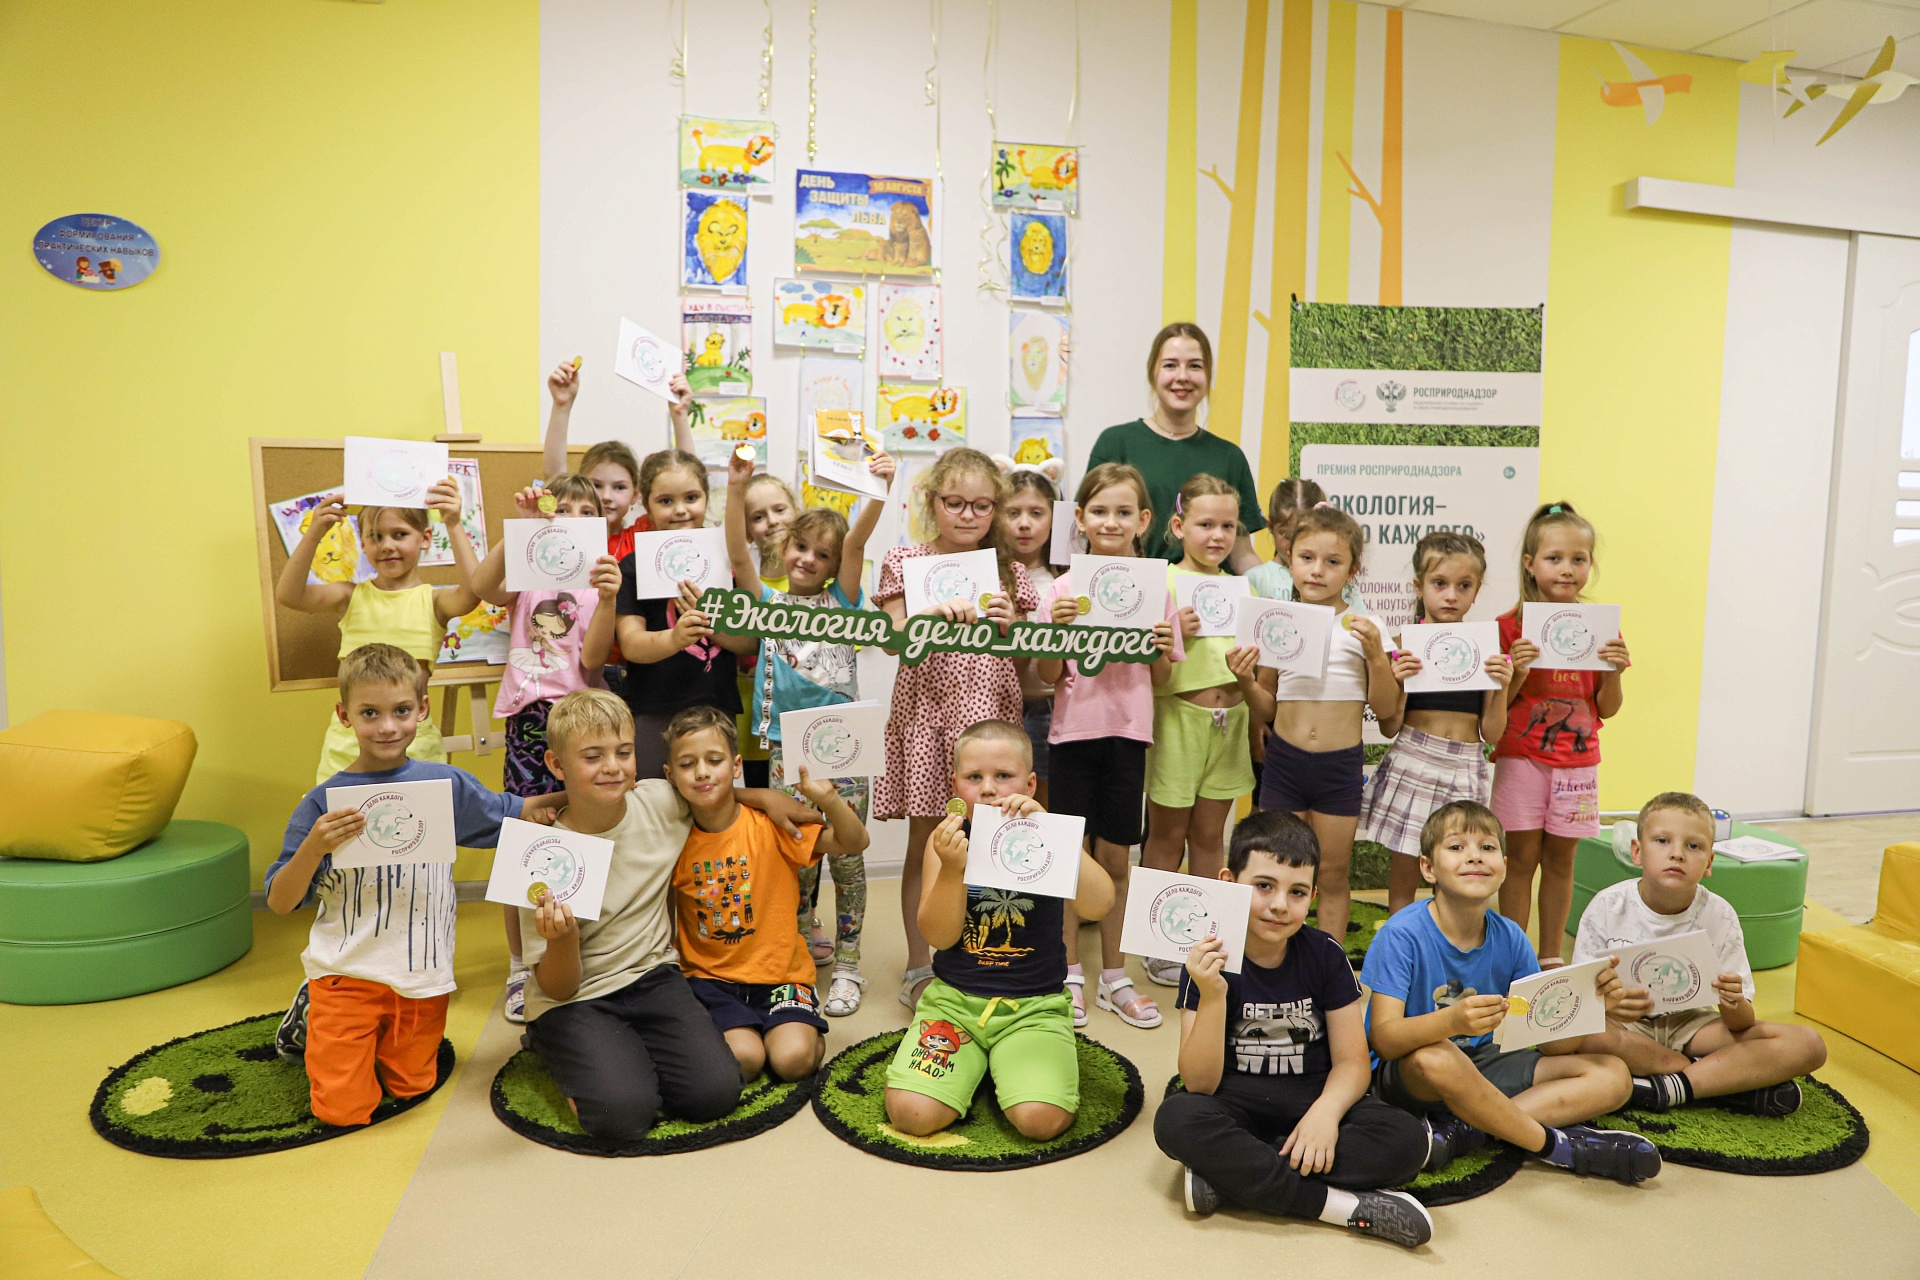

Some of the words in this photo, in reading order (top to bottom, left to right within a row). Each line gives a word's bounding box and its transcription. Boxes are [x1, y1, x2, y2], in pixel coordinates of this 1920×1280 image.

[799, 174, 835, 189] ДЕНЬ
[873, 182, 883, 191] 10
[886, 182, 922, 194] АВГУСТА
[810, 190, 869, 206] ЗАЩИТЫ
[852, 211, 886, 225] ЛЬВА
[58, 229, 134, 240] ФОРМИРОВАНИЯ
[38, 241, 108, 253] ПРАКТИЧЕСКИХ
[111, 247, 154, 256] НАВЫКОВ
[1413, 387, 1497, 399] РОСПРИРОДНАДЗОР
[1317, 464, 1356, 475] ПРЕМИЯ
[1359, 465, 1462, 478] РОСПРИРОДНАДЗОРА
[1360, 582, 1402, 595] ОЛОНКИ,
[1377, 599, 1414, 611] НОУТБУ
[1152, 898, 1162, 924] ЭКОЛОГИЯ
[1165, 888, 1178, 898] ДЕЛО
[1179, 887, 1202, 897] КАЖДОГО
[1243, 1003, 1277, 1020] GET
[1279, 997, 1313, 1018] THE
[932, 1053, 955, 1073] ВАМ
[1236, 1045, 1304, 1075] WIN
[909, 1059, 945, 1080] НАДО?
